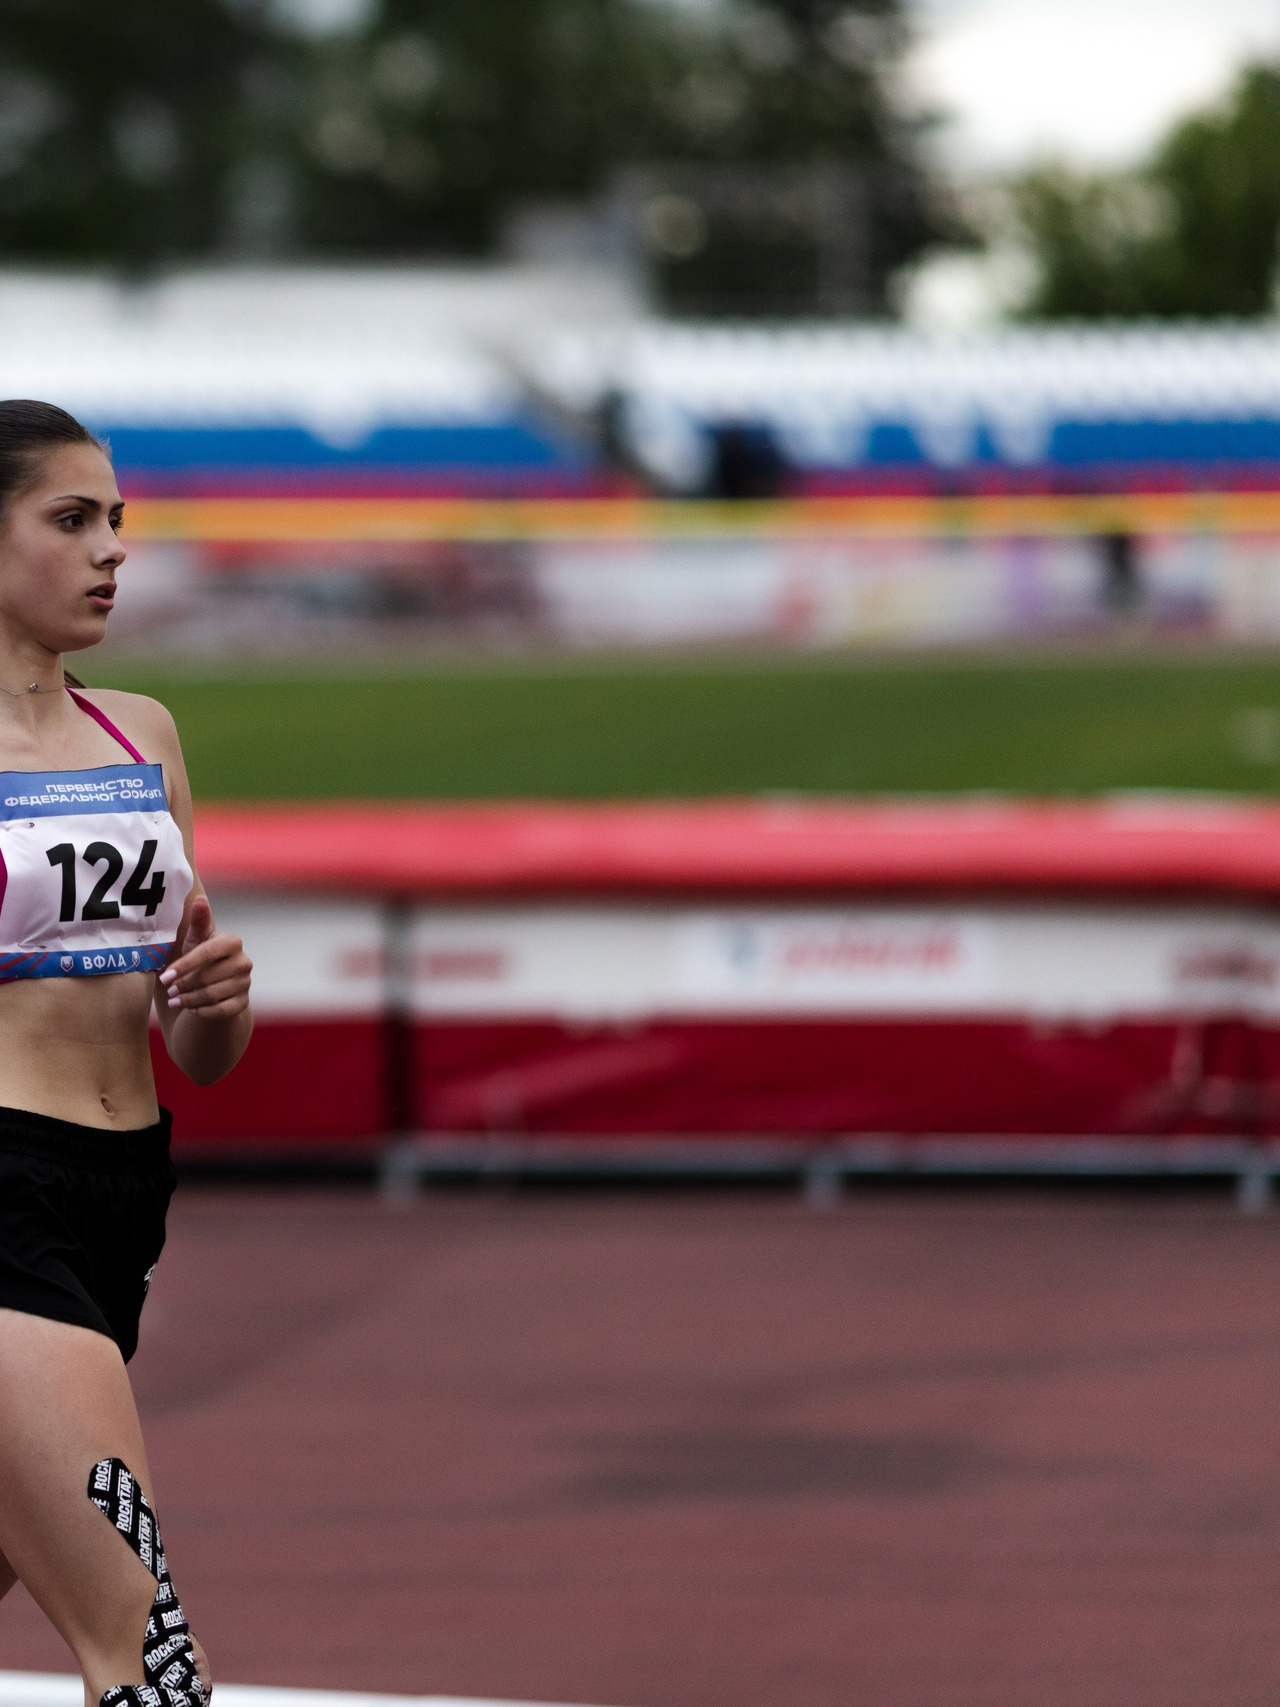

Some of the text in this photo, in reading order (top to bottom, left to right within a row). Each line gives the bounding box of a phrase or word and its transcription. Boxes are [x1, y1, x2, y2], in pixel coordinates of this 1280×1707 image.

[46, 778, 144, 793] ПЕРВЕНСТВО
[46, 839, 166, 922] 124
[82, 953, 127, 970] ВФЛА
[116, 1469, 133, 1532] ROCKTAPE
